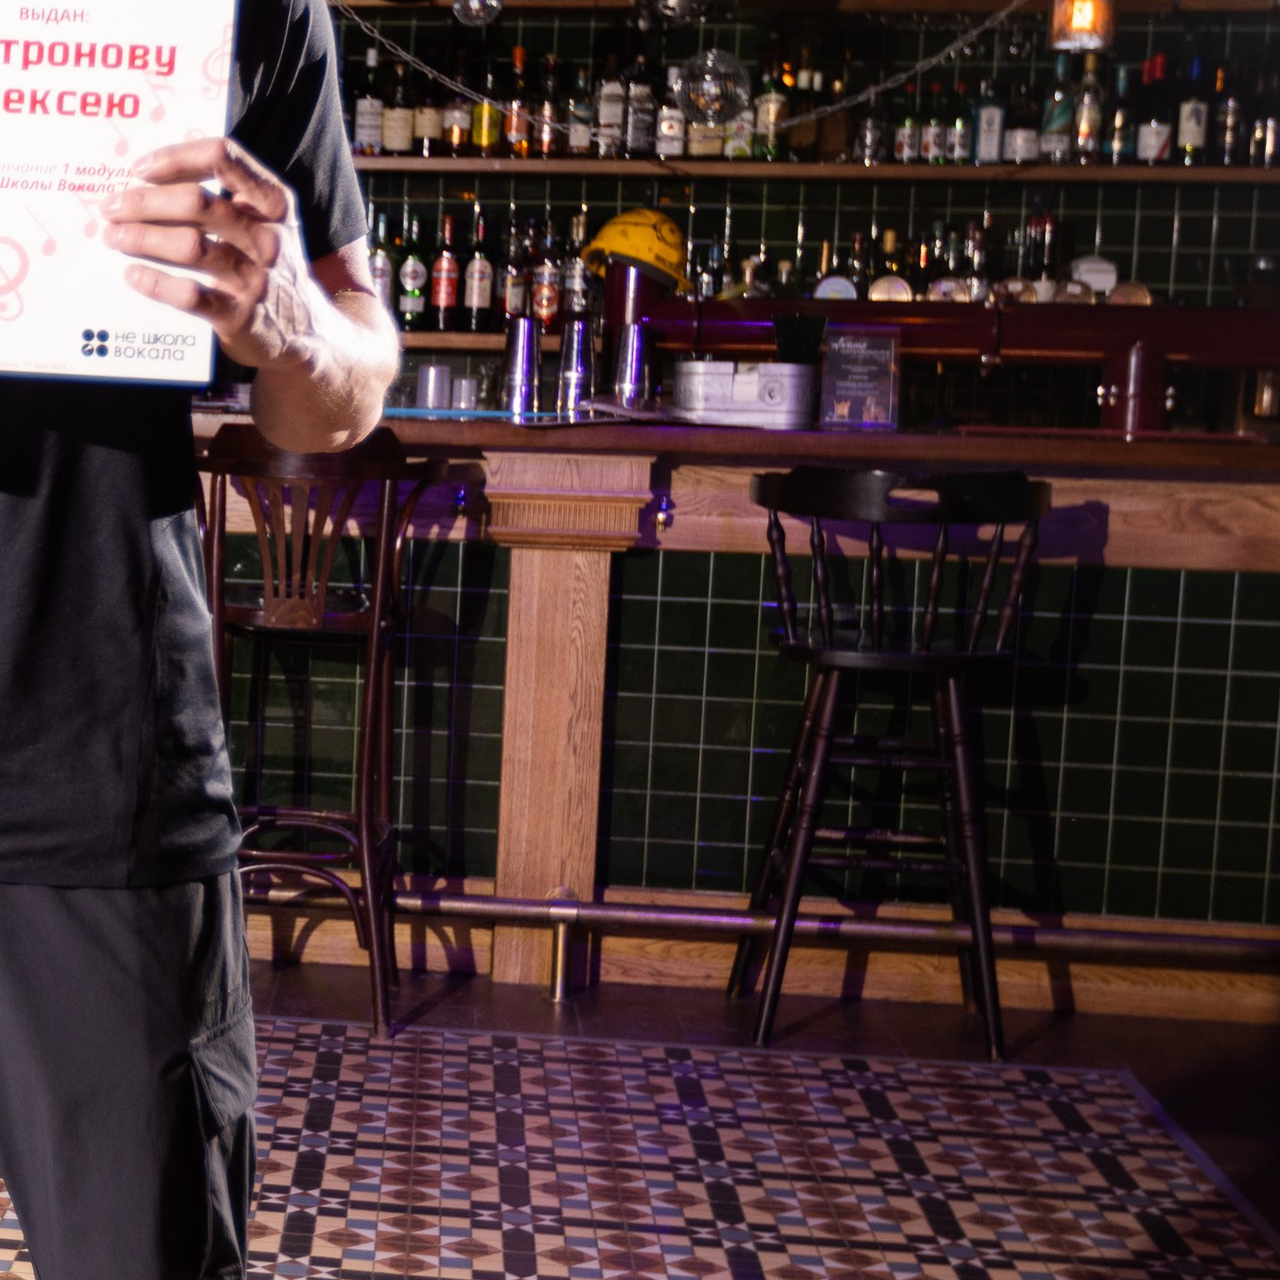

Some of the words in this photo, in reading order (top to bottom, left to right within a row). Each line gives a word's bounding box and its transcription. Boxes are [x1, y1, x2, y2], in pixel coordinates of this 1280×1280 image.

[20, 7, 90, 24] ВЫДАН:
[63, 163, 70, 176] 1
[142, 332, 196, 347] школа
[114, 346, 185, 361] вокала
